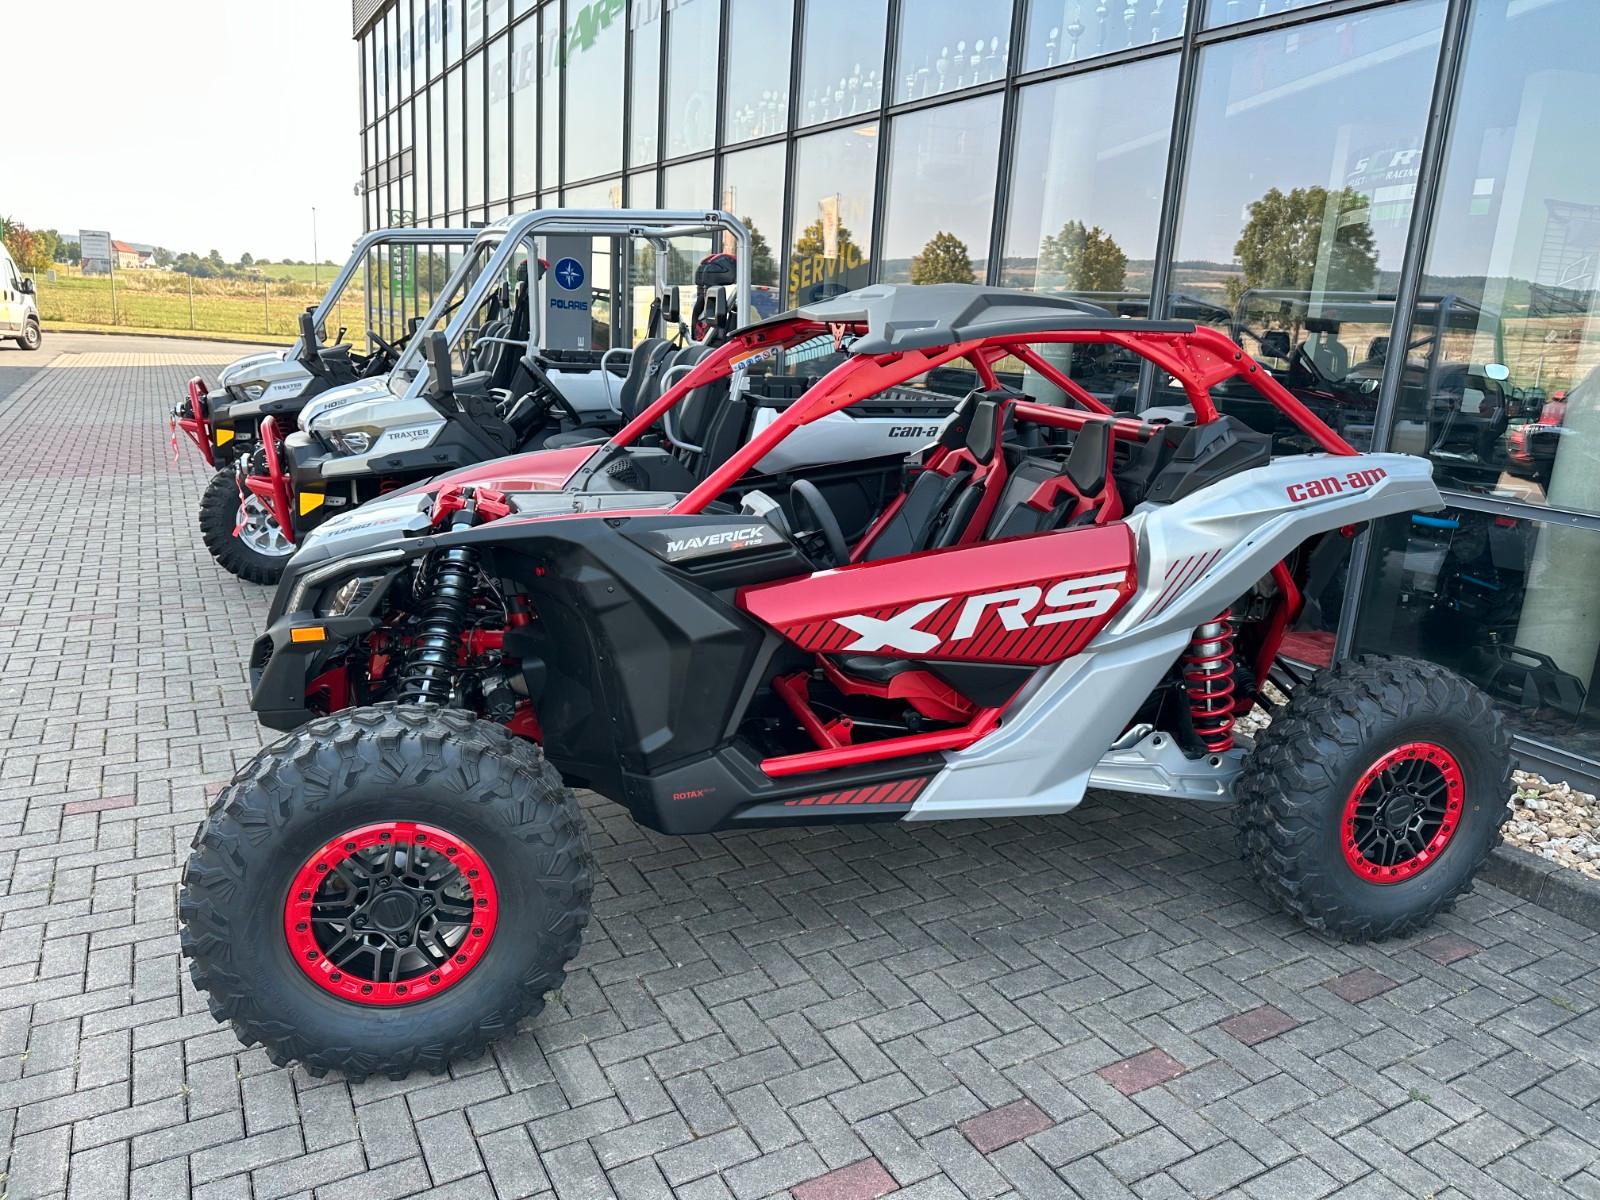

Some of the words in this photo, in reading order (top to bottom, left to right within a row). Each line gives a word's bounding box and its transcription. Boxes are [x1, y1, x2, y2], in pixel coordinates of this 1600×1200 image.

[550, 298, 588, 311] POLARIS
[387, 429, 429, 440] TRAXTER
[888, 426, 939, 438] can-a
[1285, 466, 1388, 503] can-am
[666, 525, 766, 553] MAVERICK
[673, 788, 705, 801] ROTAX
